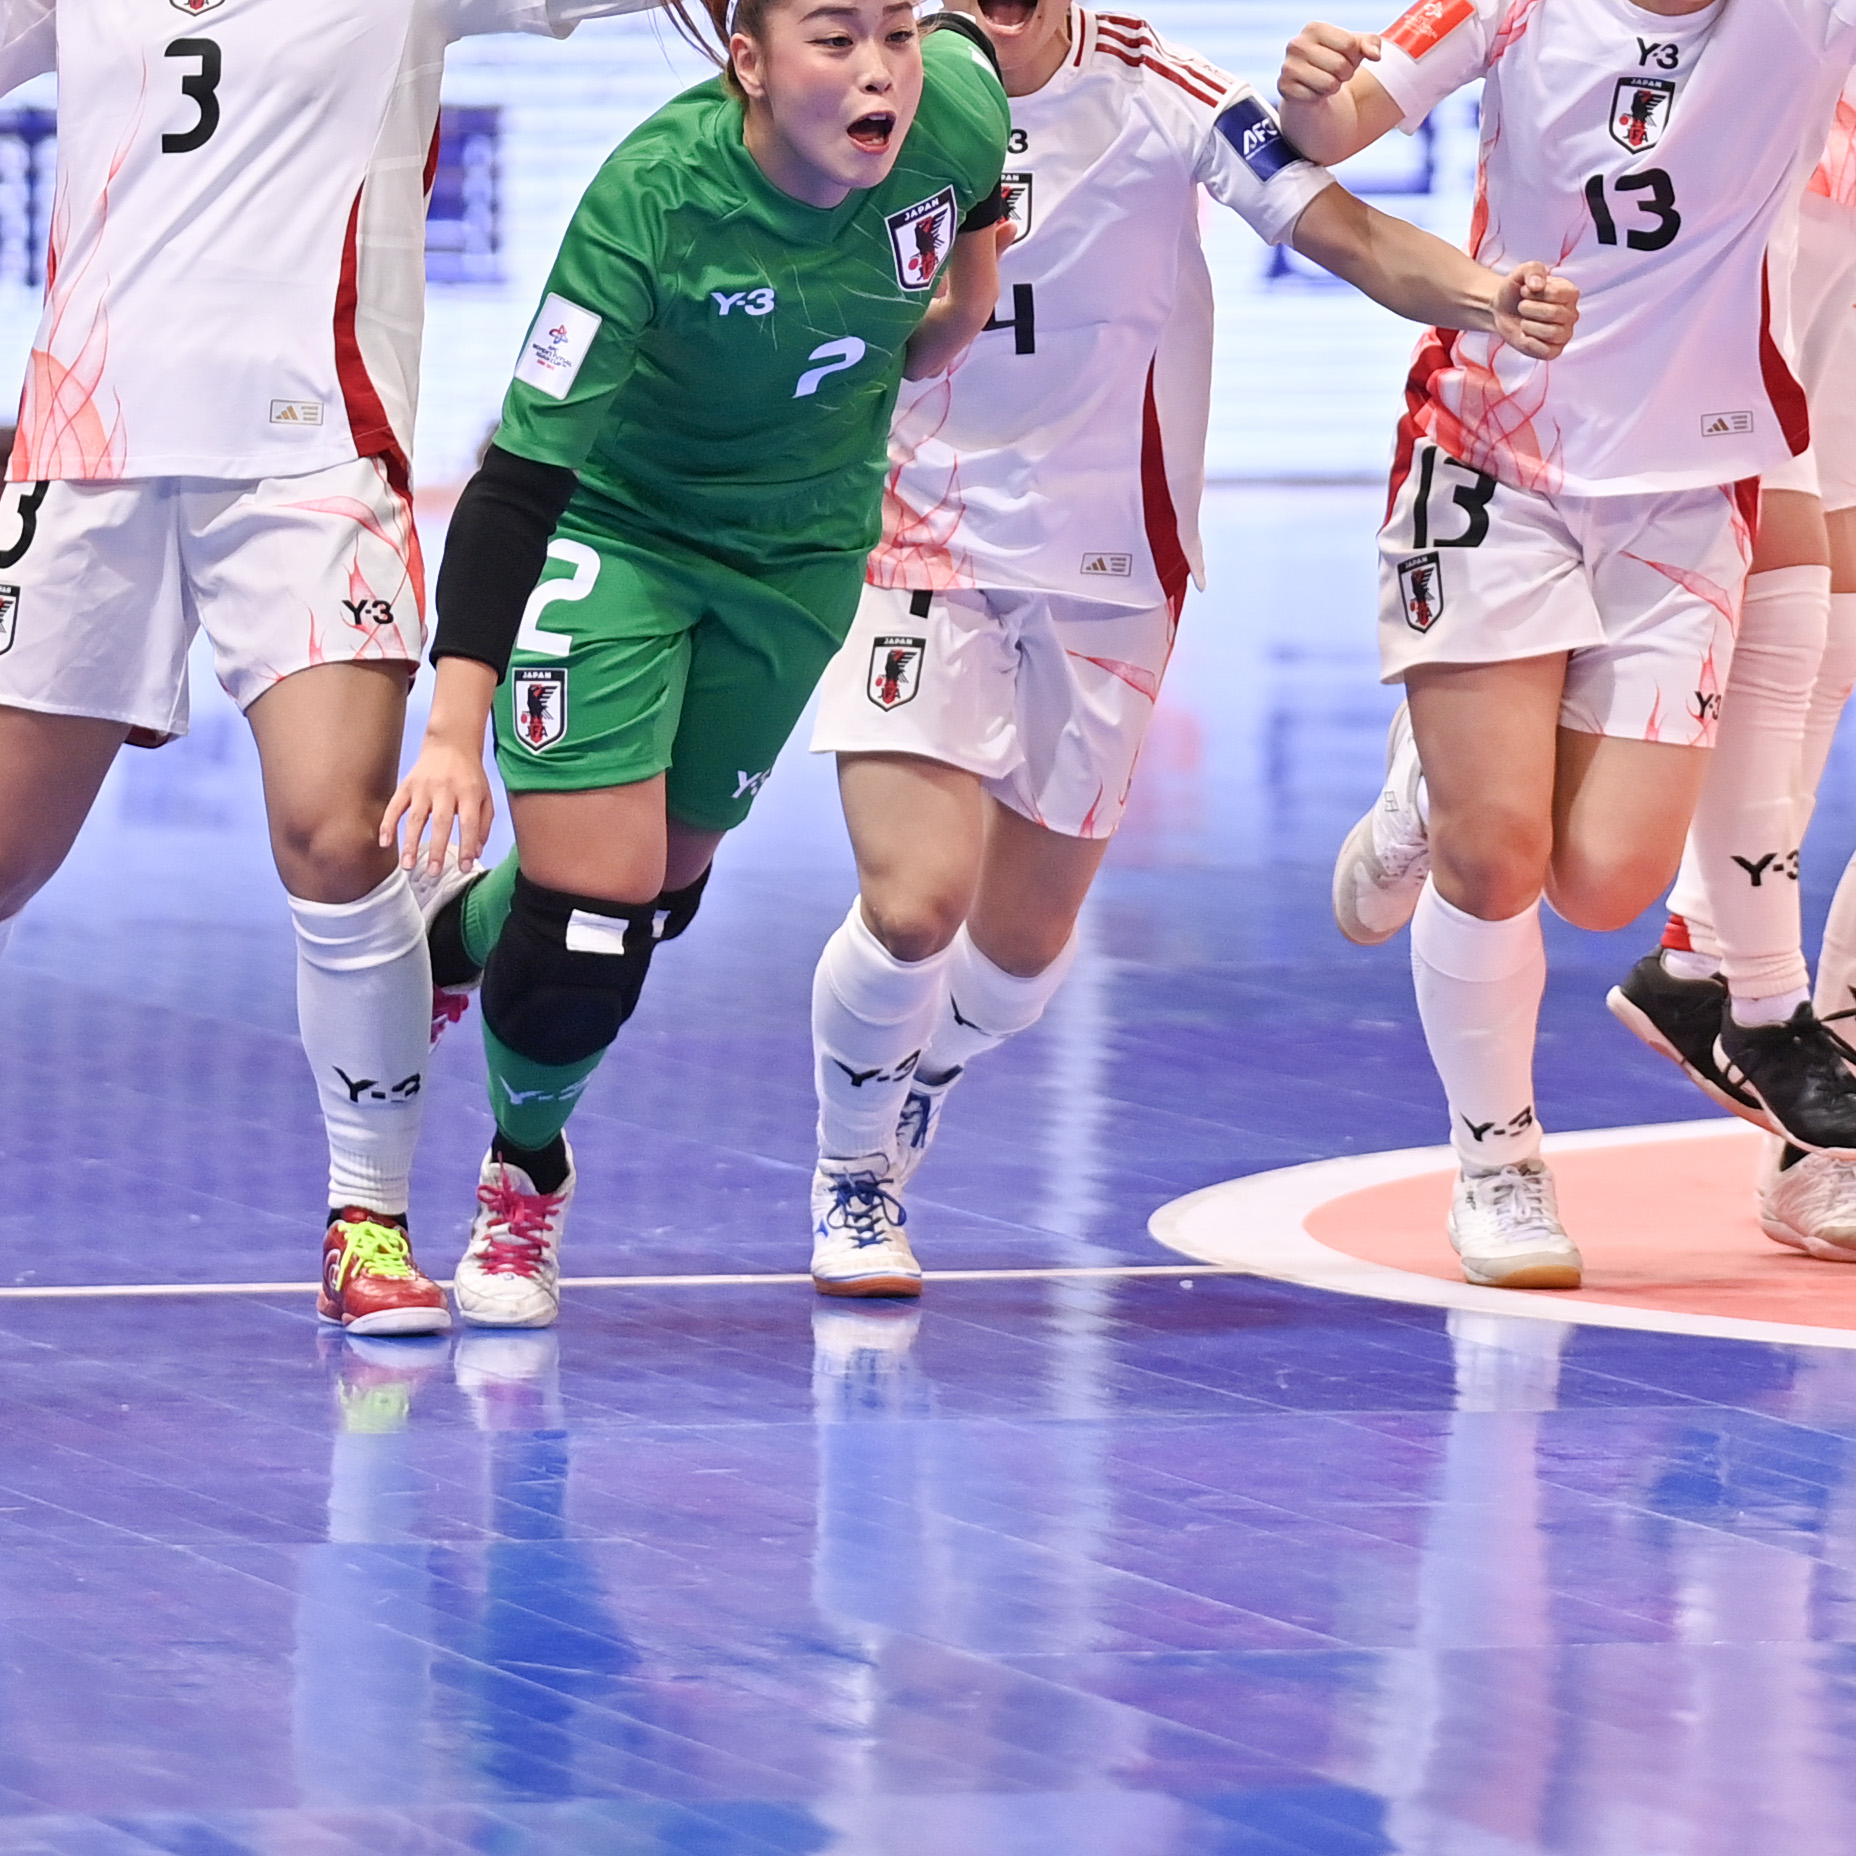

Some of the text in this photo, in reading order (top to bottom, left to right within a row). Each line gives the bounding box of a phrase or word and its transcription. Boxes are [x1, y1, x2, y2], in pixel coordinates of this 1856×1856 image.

[1637, 37, 1679, 70] Y-3
[161, 37, 222, 154] 3
[1630, 78, 1663, 89] JAPAN
[1243, 119, 1277, 156] AFC
[903, 196, 940, 222] JAPAN
[1584, 167, 1682, 252] 13
[710, 288, 776, 316] Y-3
[1413, 445, 1498, 549] 13
[517, 538, 602, 657] 2
[343, 600, 394, 626] Y-3
[883, 637, 914, 647] JAPAN
[522, 670, 552, 680] JAPAN
